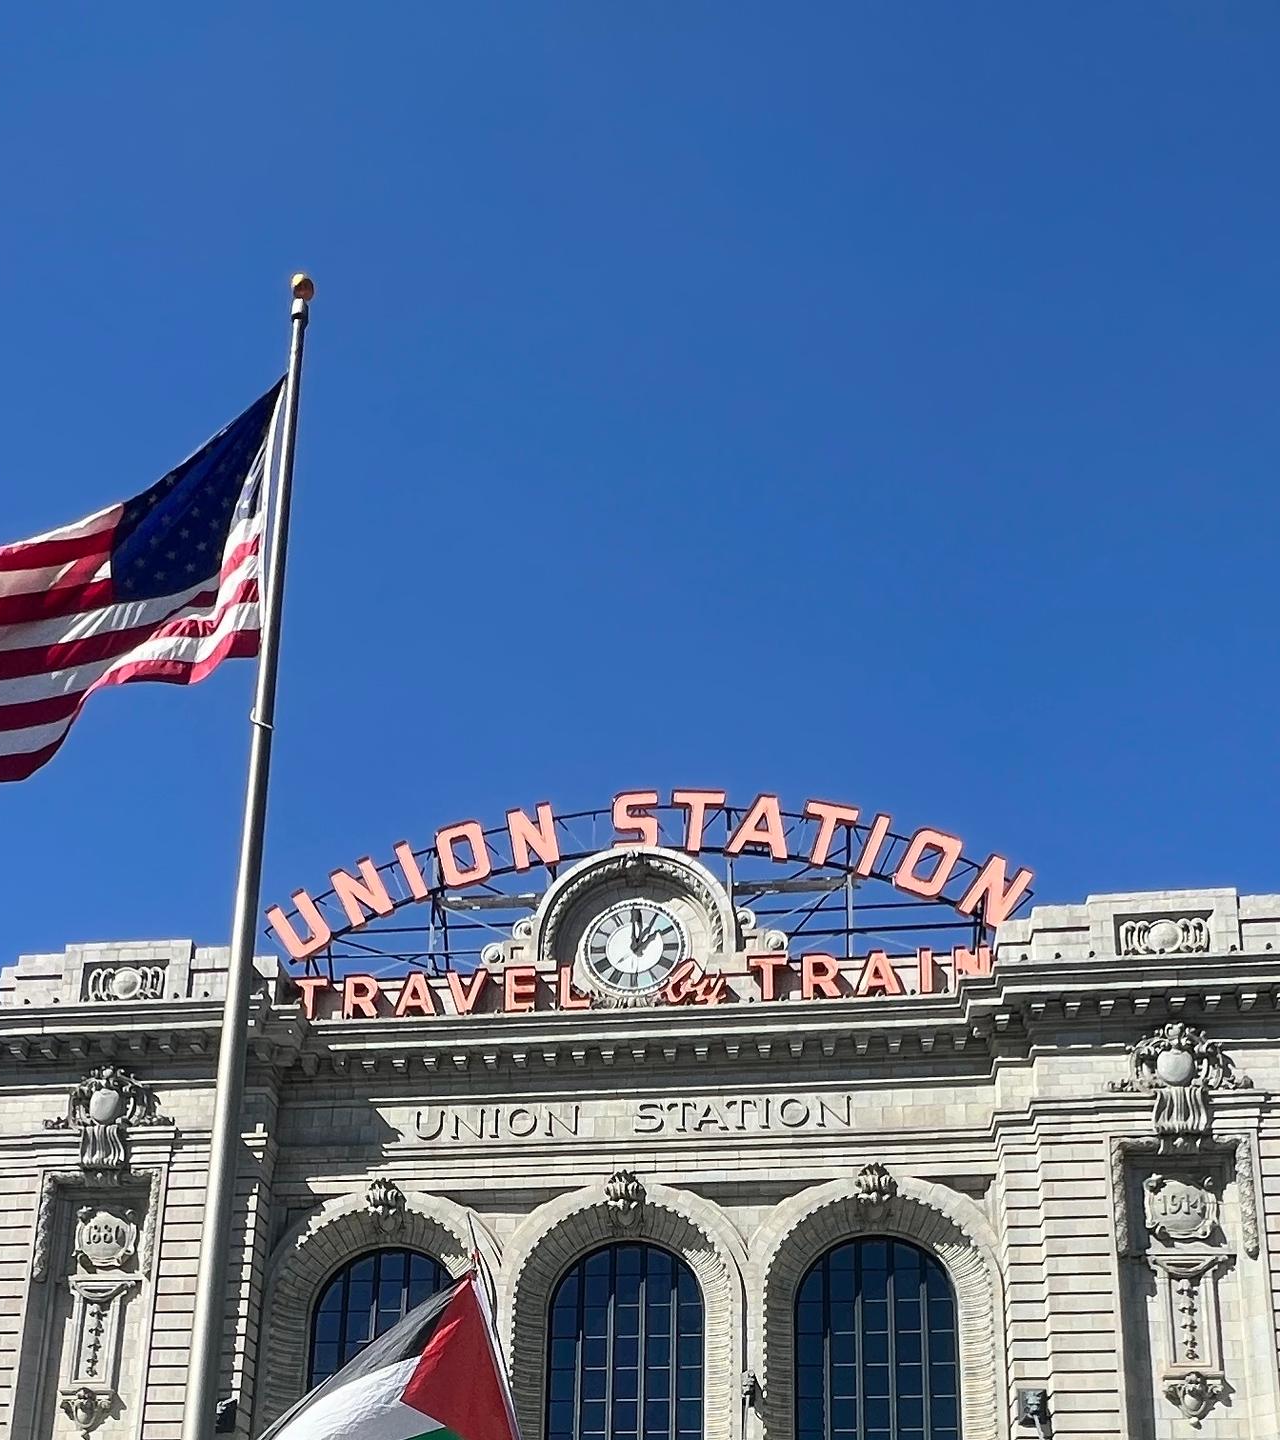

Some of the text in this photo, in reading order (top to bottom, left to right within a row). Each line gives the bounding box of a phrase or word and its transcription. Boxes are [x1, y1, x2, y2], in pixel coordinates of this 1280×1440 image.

[265, 788, 1034, 961] UNION STATION
[289, 944, 995, 1020] TRAVEL by TRAIN
[415, 1094, 853, 1141] UNION STATION
[1157, 1194, 1204, 1216] 1914
